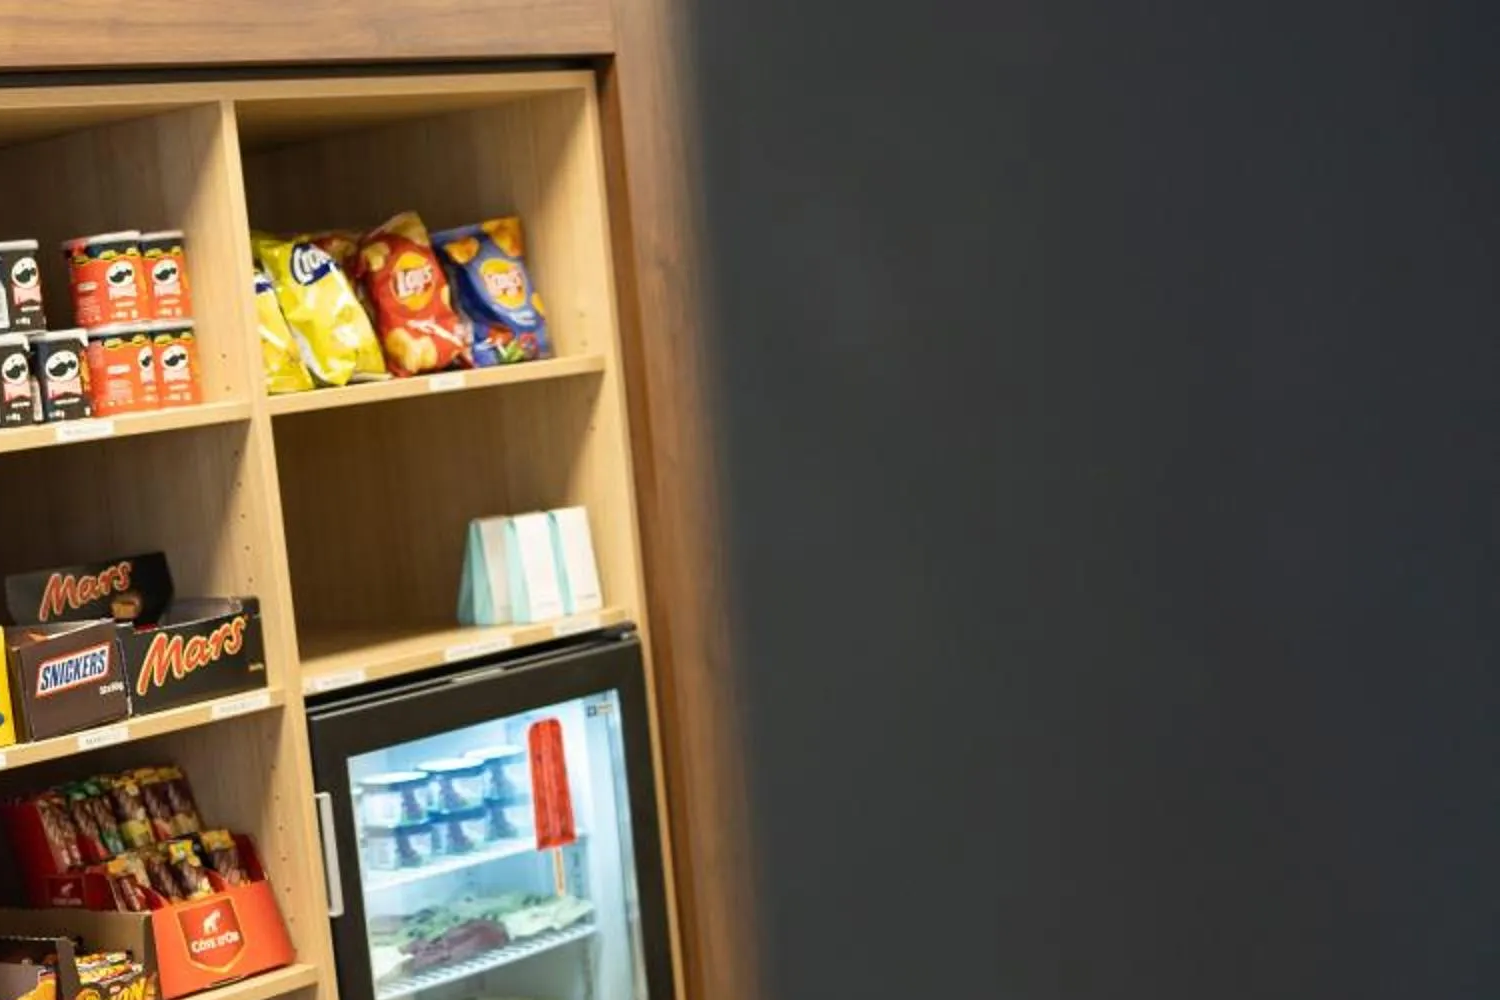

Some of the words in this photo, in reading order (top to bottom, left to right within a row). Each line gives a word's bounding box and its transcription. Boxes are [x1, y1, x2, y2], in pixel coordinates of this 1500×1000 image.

[39, 561, 131, 621] Mars
[40, 650, 106, 690] SNICKERS
[136, 614, 248, 696] Mars
